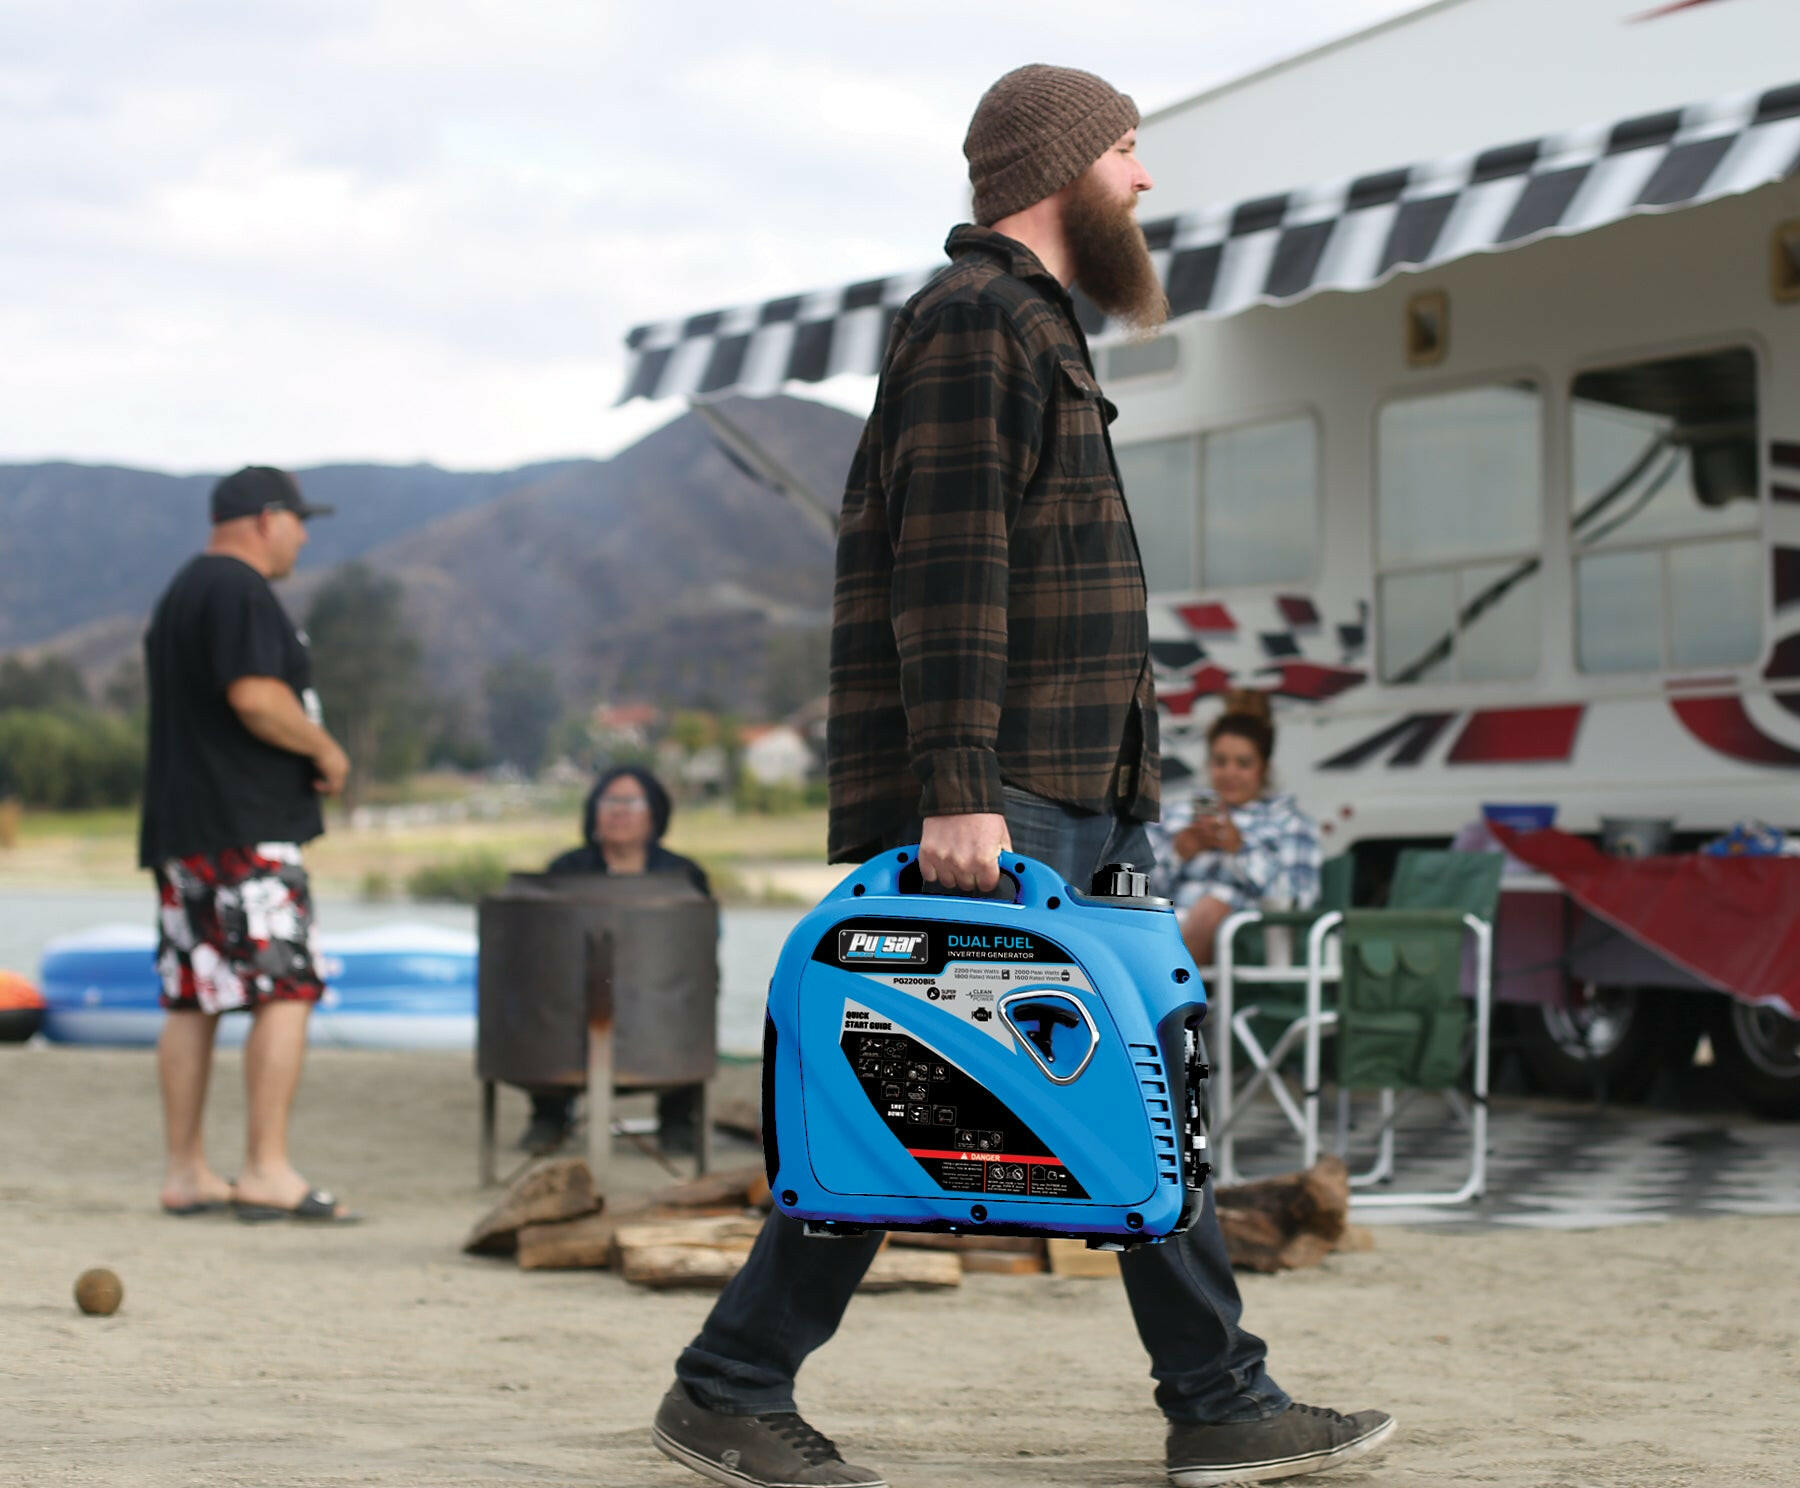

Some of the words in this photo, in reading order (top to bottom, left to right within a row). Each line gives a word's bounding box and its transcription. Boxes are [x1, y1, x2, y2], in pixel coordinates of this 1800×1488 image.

[948, 935, 991, 948] DUAL
[994, 936, 1034, 949] FUEL
[846, 1011, 869, 1020] QUICK
[845, 1021, 868, 1029] START
[869, 1022, 892, 1031] GUIDE
[971, 1153, 1001, 1161] DANGER
